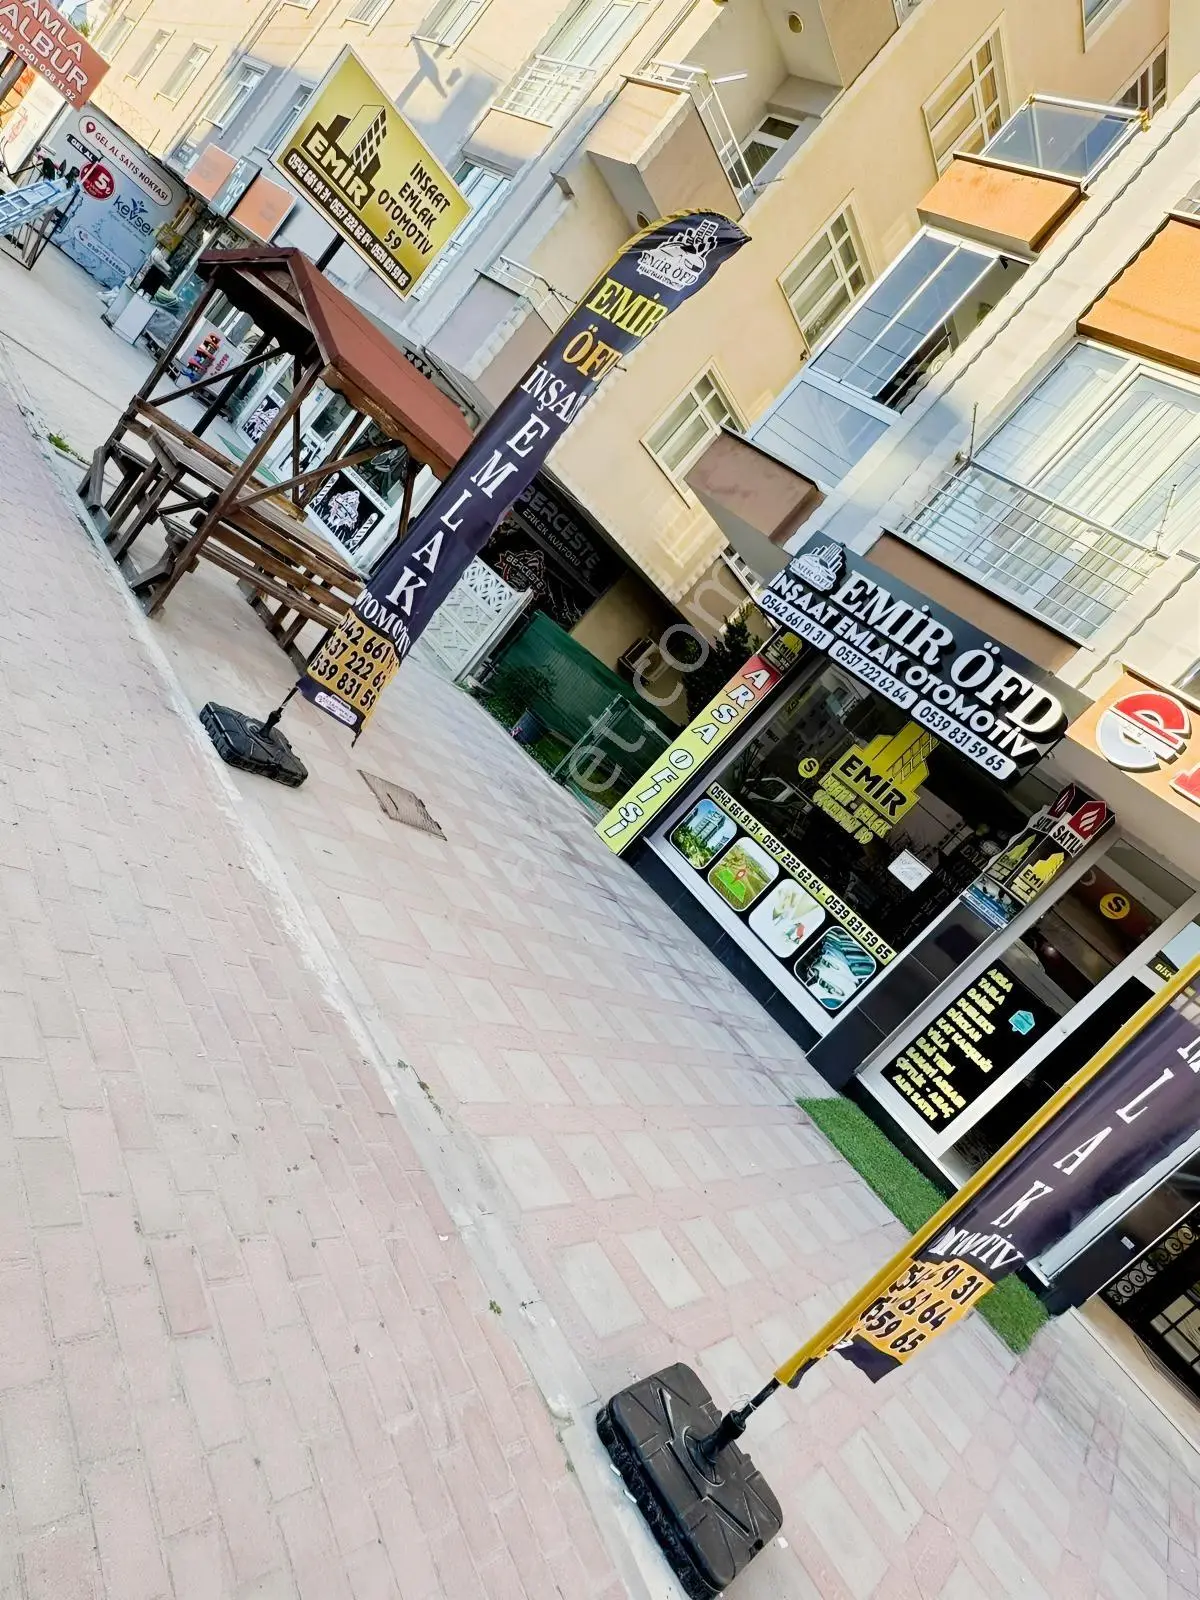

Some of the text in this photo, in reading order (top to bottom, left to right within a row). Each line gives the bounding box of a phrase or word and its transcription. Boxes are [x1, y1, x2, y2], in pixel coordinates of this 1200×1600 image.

[65, 89, 76, 101] 92
[94, 132, 109, 148] GEL
[109, 145, 118, 157] AL
[139, 172, 168, 201] NOKTASI
[288, 153, 307, 178] 0542
[306, 129, 368, 207] EMİR
[377, 189, 434, 256] OTOMOTİV
[398, 182, 437, 231] EMLAK
[384, 229, 402, 250] 59
[640, 250, 673, 276] EMİR
[586, 277, 669, 337] EMİR
[520, 485, 601, 569] BERCESTE
[345, 651, 374, 681] 222
[363, 636, 391, 663] 661
[768, 569, 839, 625] İNŞAAT
[833, 616, 908, 674] EMLAK
[905, 665, 1037, 757] OTOMOTİV
[829, 570, 1064, 734] EMİR ÖFD
[337, 672, 362, 699] 831
[691, 669, 771, 745] ARSA
[762, 594, 1006, 771] 0542 661 91 31 0537 222 62 64 0539 831 59 65
[839, 754, 908, 817] EMİR
[710, 785, 893, 960] 0542 661 91 31 0537 222 62 64 0539 831 59 65
[917, 1299, 953, 1331] 64
[950, 1275, 983, 1305] 31
[865, 1310, 903, 1338] 59
[889, 1327, 927, 1353] 65
